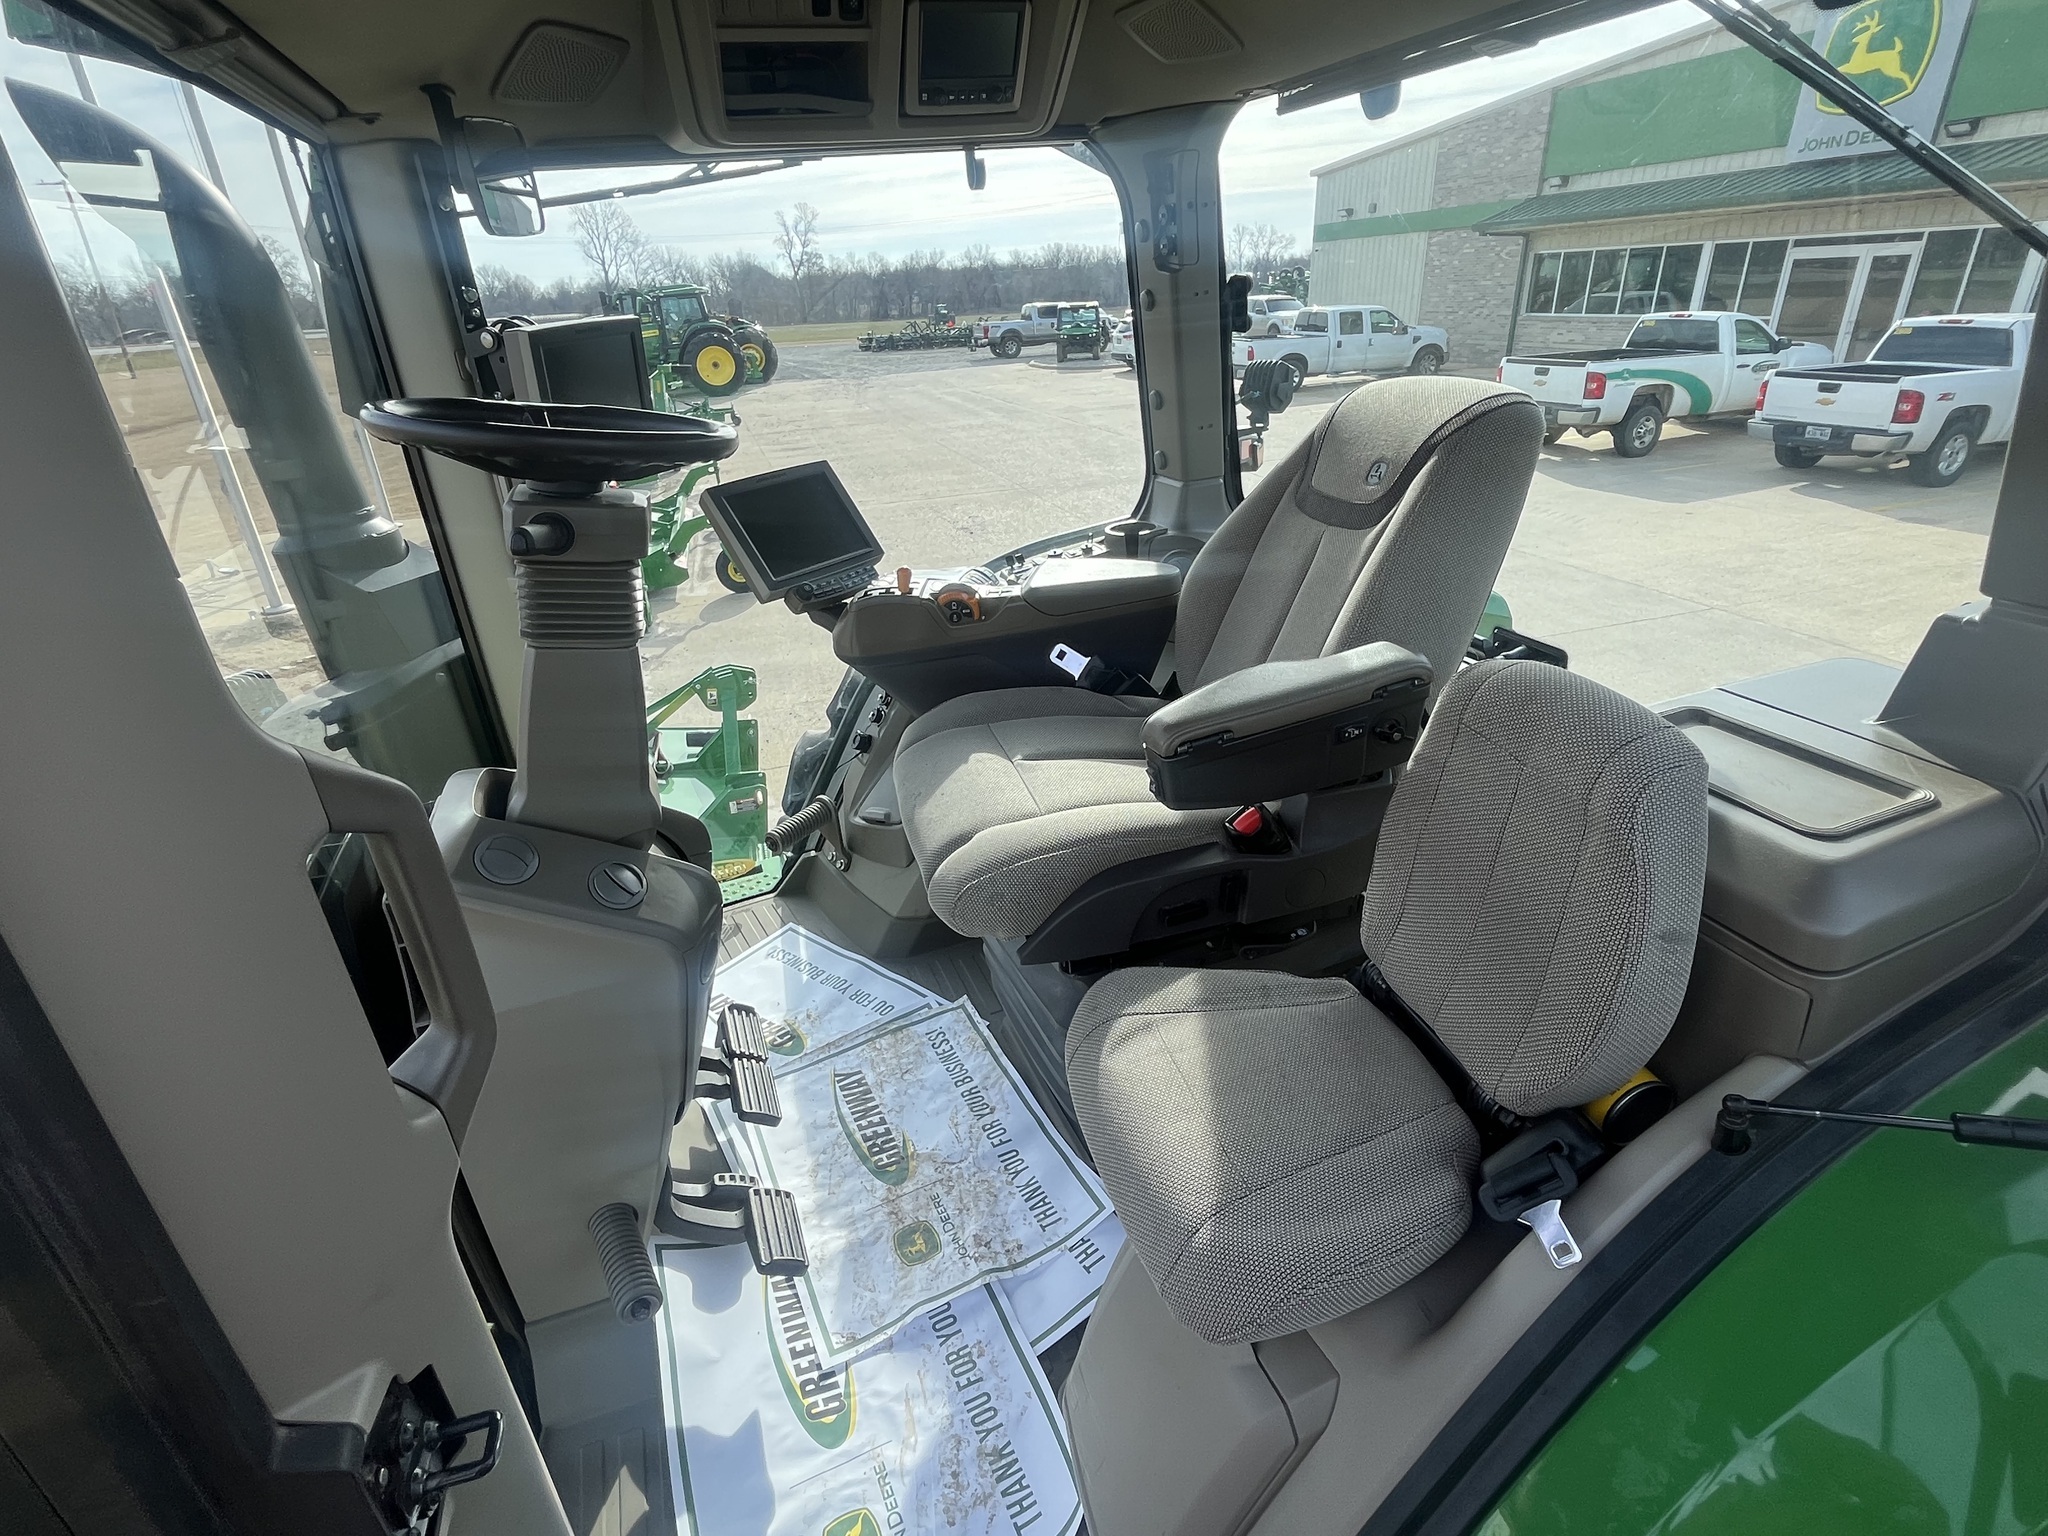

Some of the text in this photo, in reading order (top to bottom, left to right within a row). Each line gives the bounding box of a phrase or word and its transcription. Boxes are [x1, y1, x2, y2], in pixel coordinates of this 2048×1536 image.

[1798, 130, 1886, 154] JOHN DEE
[765, 946, 896, 1017] OU FOR YOUR BUSINESS!
[834, 1069, 905, 1170] GREENWAY
[925, 1026, 1062, 1233] THANK YOU FOR YOUR BUSINESS!
[929, 1192, 974, 1260] JOHN DEERE
[1068, 1236, 1106, 1275] THA
[770, 1275, 847, 1421] GREENWA
[926, 1301, 1043, 1536] THANK YOU FOR YOU
[873, 1460, 904, 1530] DEERE
